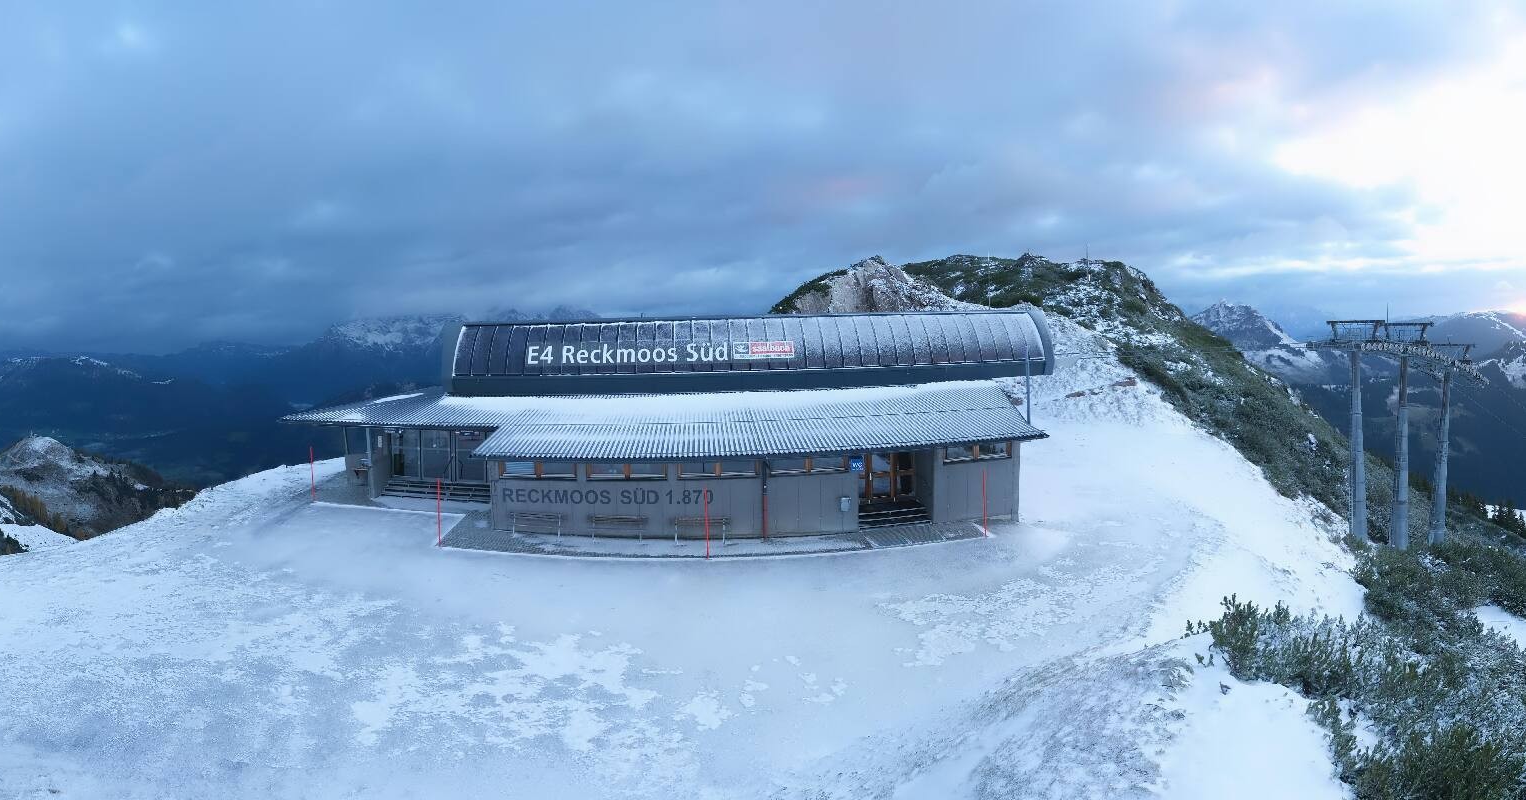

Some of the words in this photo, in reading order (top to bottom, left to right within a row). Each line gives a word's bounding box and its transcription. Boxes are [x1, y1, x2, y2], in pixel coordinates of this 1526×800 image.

[527, 345, 554, 365] E4
[562, 343, 678, 364] Reckmoos
[687, 342, 729, 362] Süd
[501, 487, 612, 505] RECKMOOS
[620, 486, 660, 505] SÜD
[665, 488, 714, 505] 1.870
